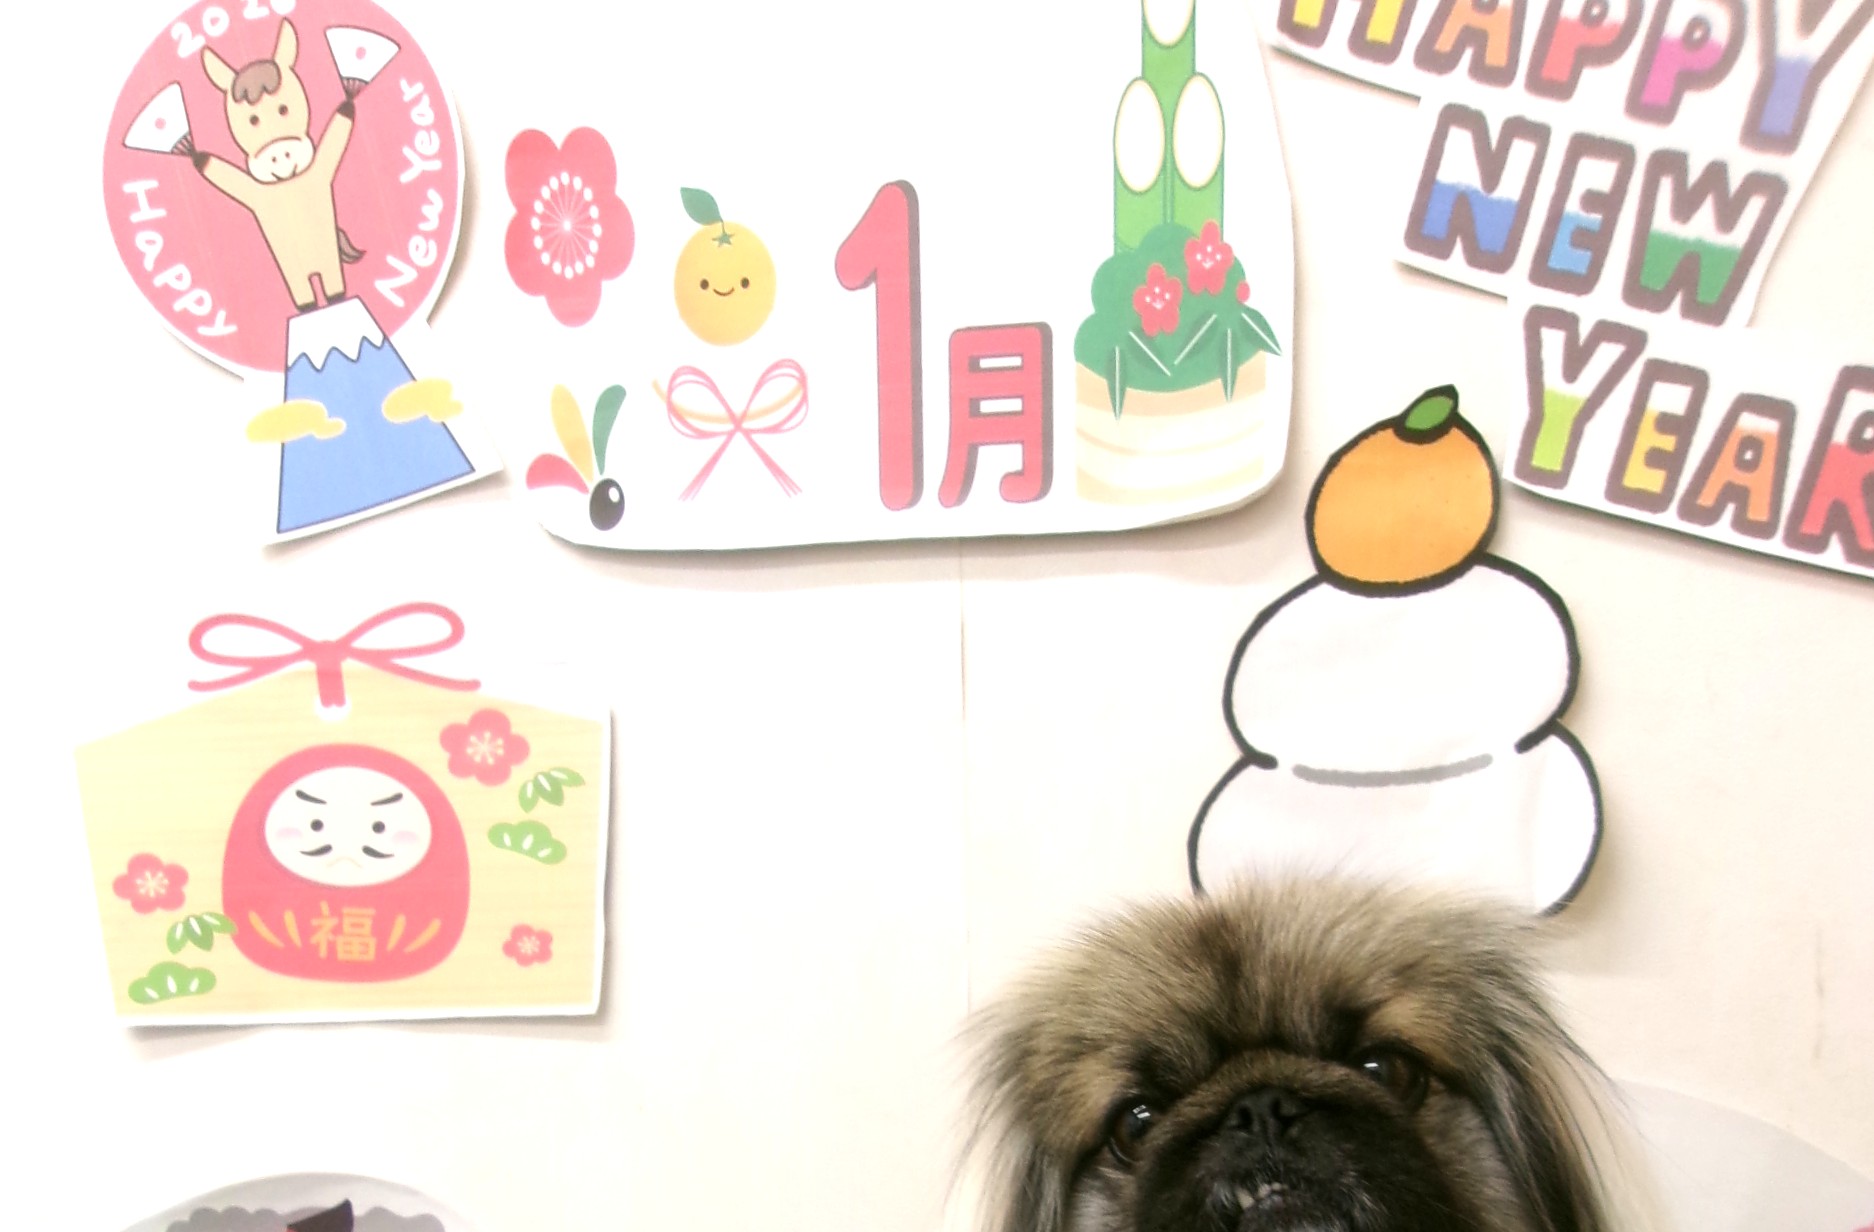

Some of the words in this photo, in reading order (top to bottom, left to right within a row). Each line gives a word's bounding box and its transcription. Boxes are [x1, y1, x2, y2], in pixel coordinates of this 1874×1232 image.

[400, 77, 442, 183] Year
[123, 180, 238, 337] Happy
[373, 188, 444, 308] New
[1405, 103, 1788, 326] NEW
[835, 179, 1053, 511] 1月
[1514, 305, 1874, 569] YEAR
[310, 901, 376, 961] 福
